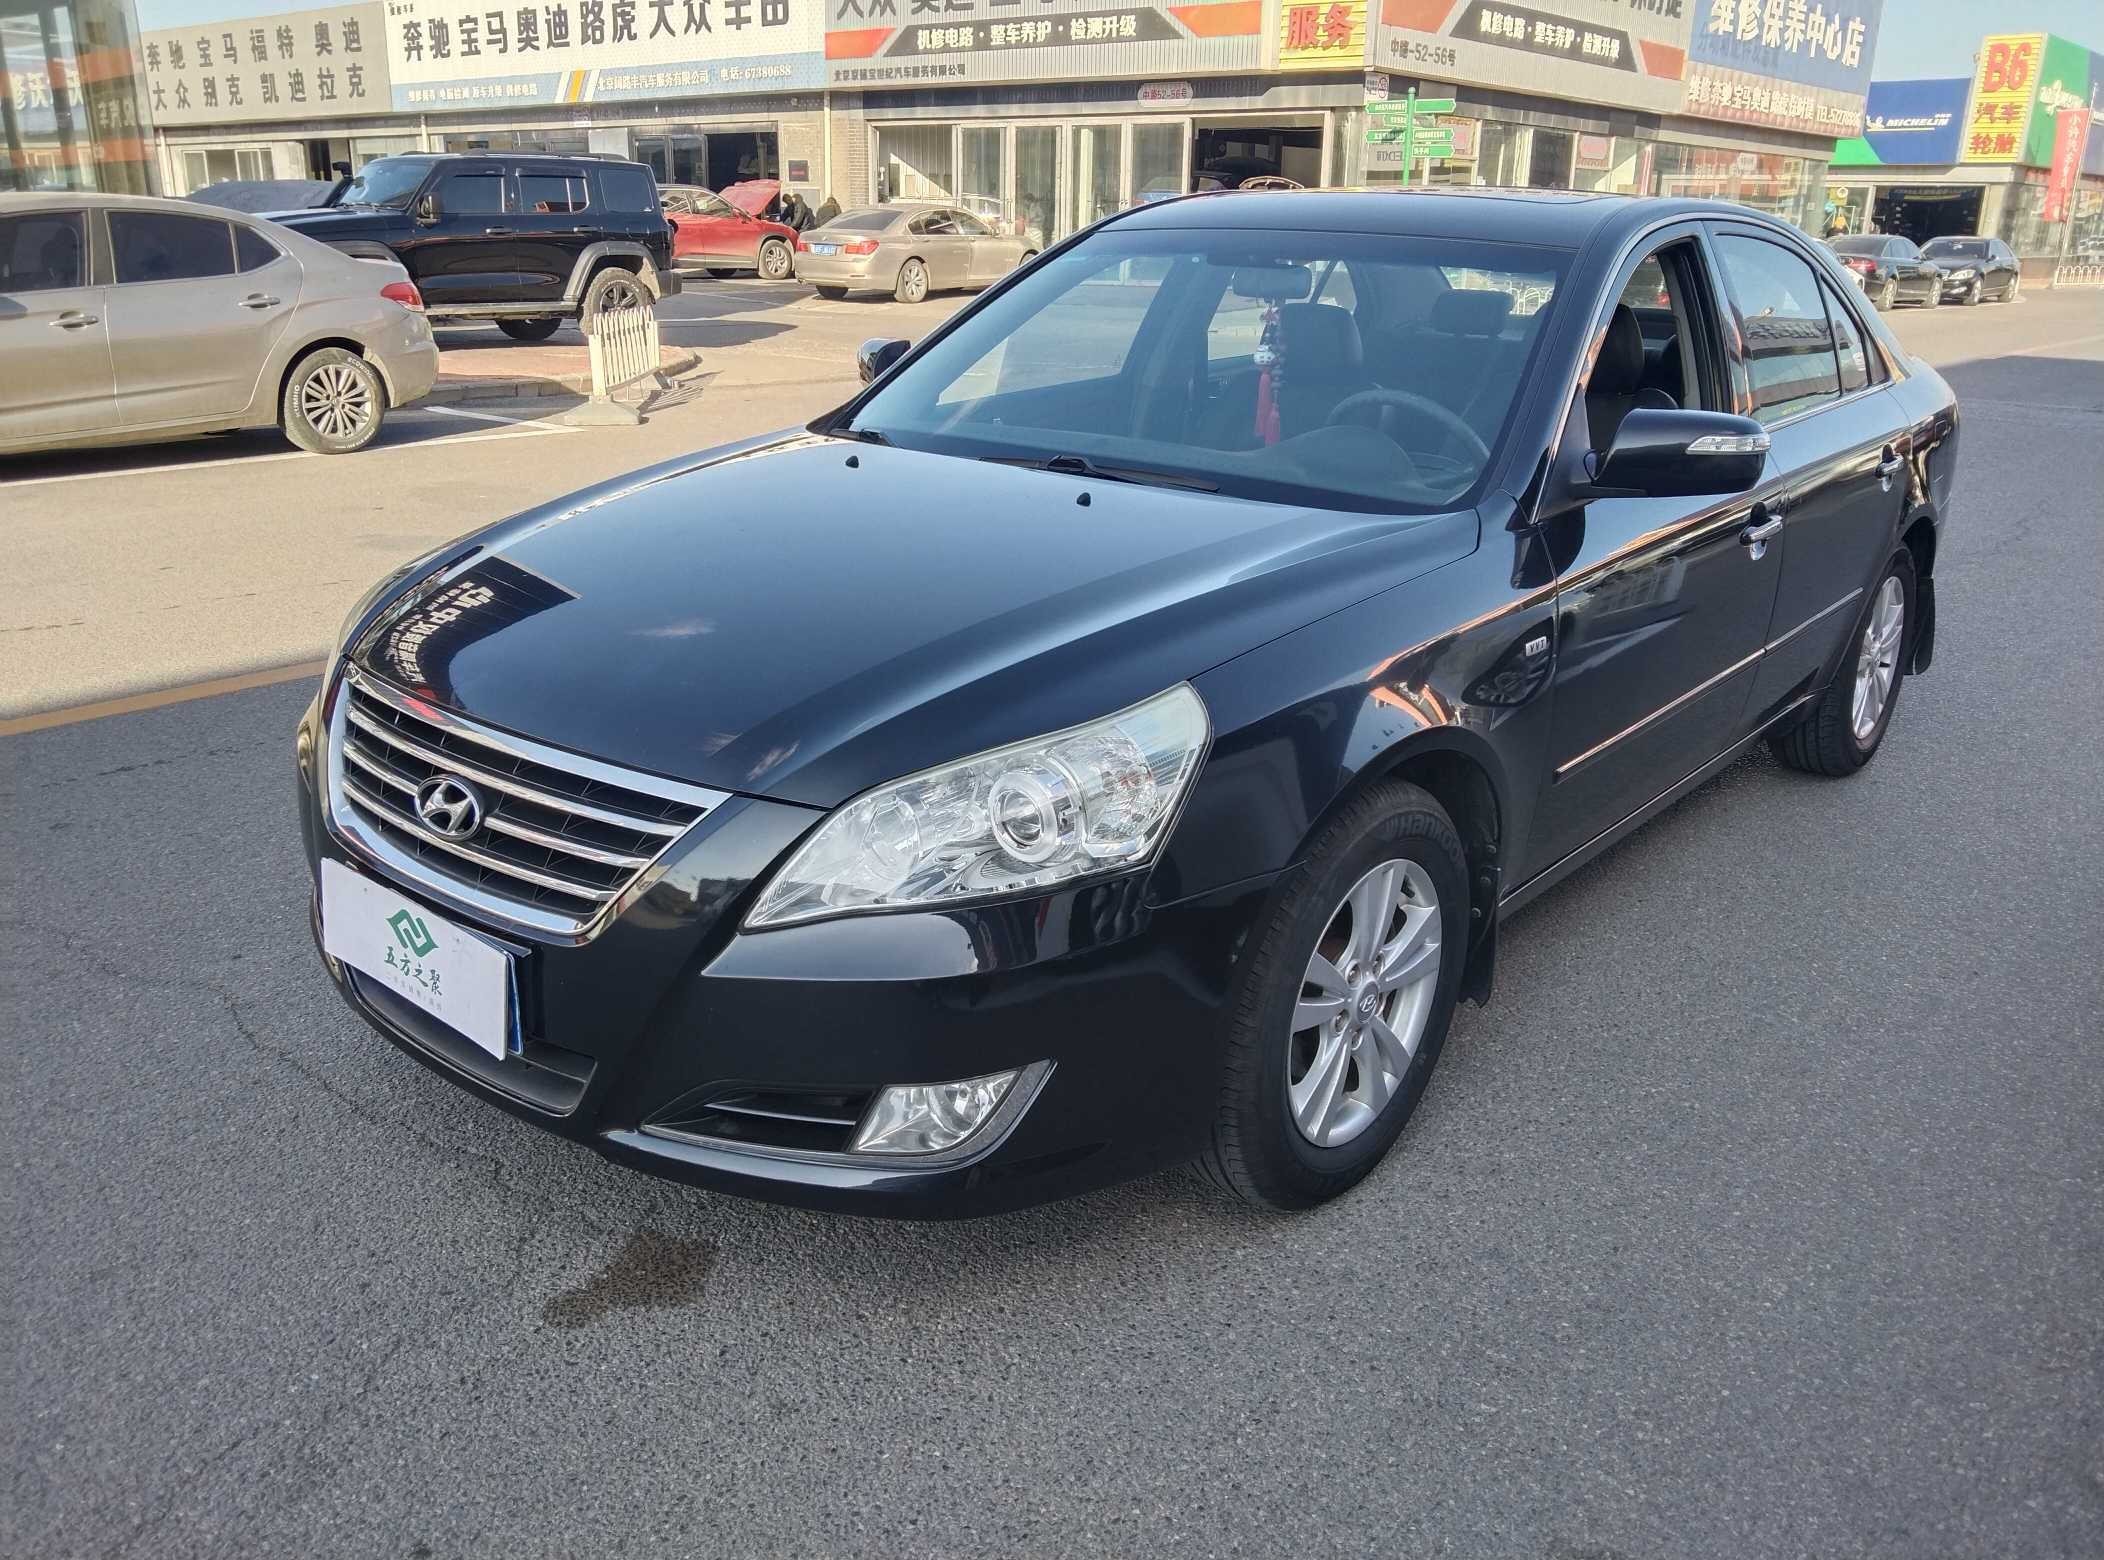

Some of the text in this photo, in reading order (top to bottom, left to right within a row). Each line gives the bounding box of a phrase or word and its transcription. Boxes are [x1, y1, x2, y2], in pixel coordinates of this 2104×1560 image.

[1285, 2, 1359, 51] 服务
[1709, 0, 1866, 68] 维修保养中心店
[1982, 42, 2033, 93] B6
[1885, 118, 1950, 127] MICHELIN
[1975, 102, 2023, 124] 汽车
[384, 946, 442, 996] 五方之聚
